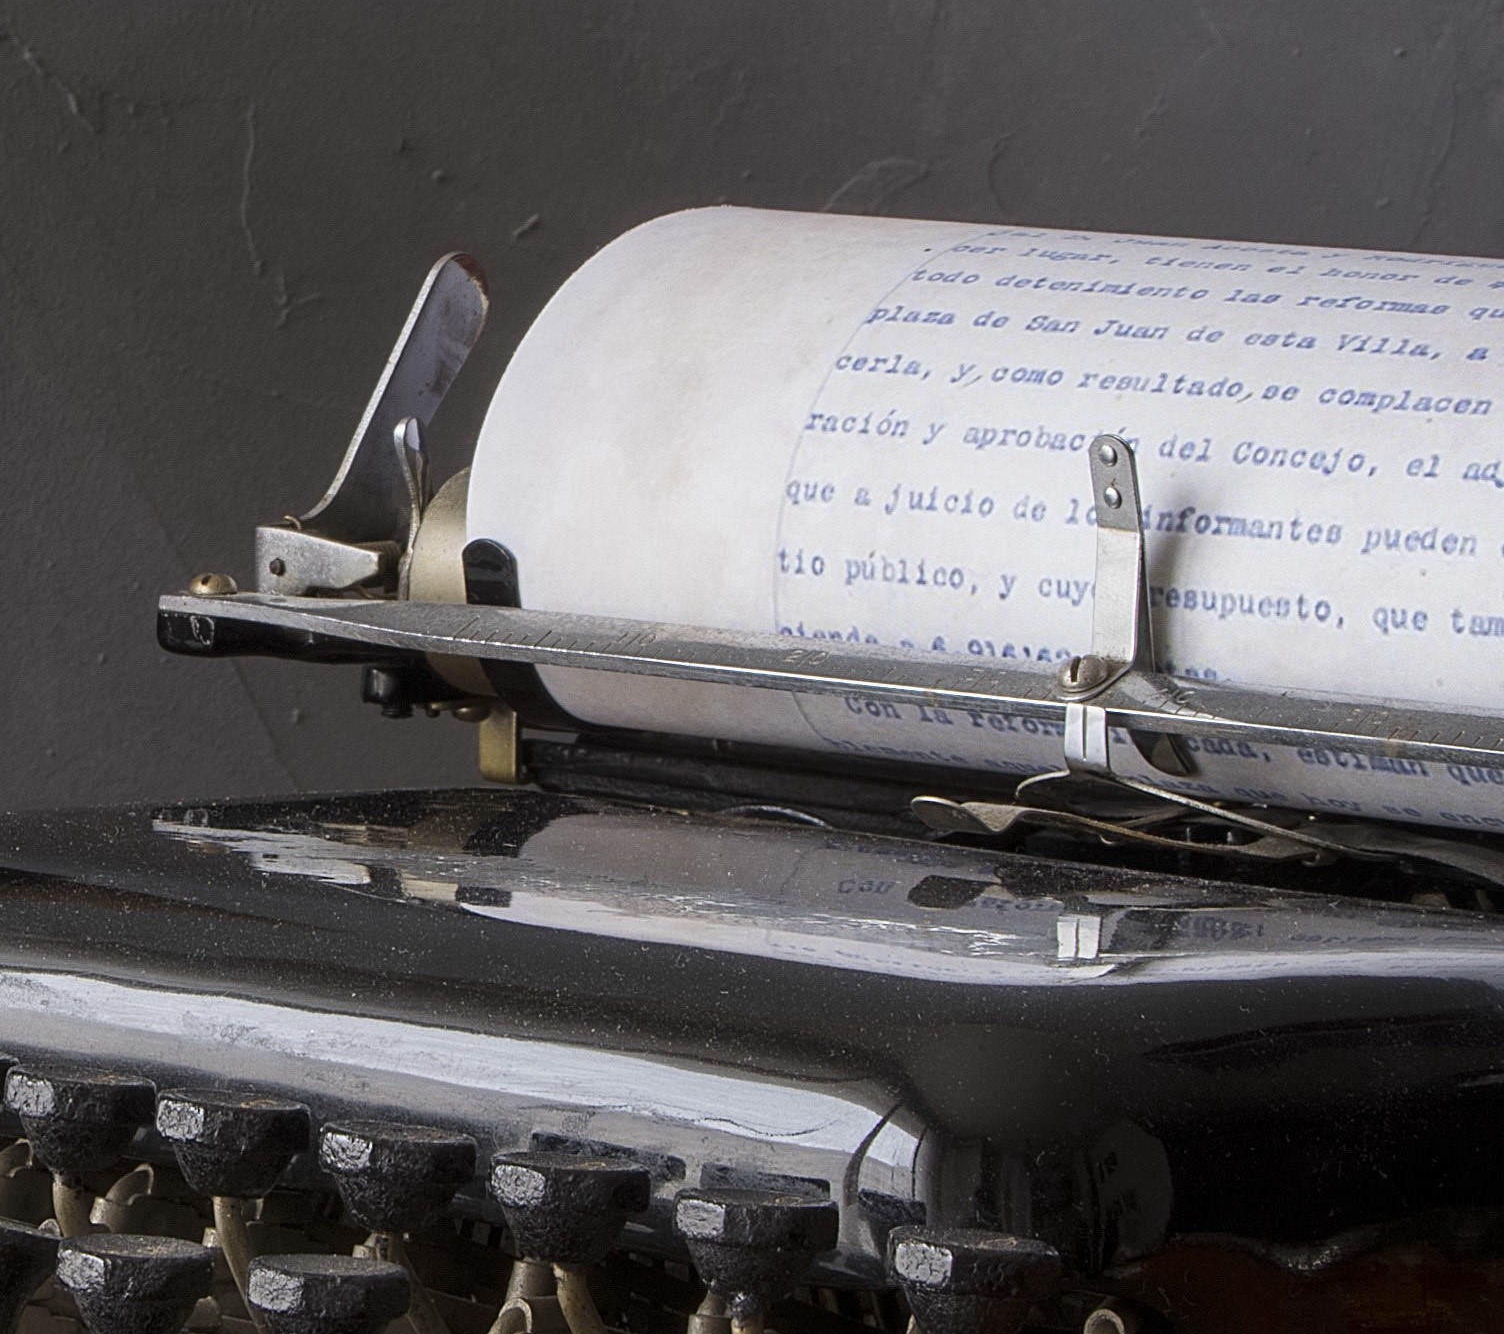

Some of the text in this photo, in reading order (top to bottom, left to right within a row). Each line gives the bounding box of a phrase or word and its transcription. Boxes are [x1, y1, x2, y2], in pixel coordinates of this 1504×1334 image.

[951, 243, 1008, 255] cer
[1018, 247, 1120, 266] lugar,
[1144, 255, 1253, 272] tienen
[1265, 265, 1307, 275] el
[1318, 267, 1421, 282] honor
[1433, 274, 1475, 286] de
[1113, 237, 1190, 248] Juan
[911, 268, 981, 286] todo
[993, 274, 1210, 301] detenimiento
[1222, 288, 1283, 305] las
[1295, 295, 1452, 316] reformas
[869, 305, 957, 327] plaza
[972, 310, 1011, 330] de
[1023, 314, 1082, 335] San
[1092, 318, 1171, 341] Juan
[1185, 324, 1226, 345] de
[1243, 330, 1318, 351] esta
[1335, 332, 1442, 361] Villa,
[1464, 346, 1491, 362] a
[833, 352, 932, 381] cerla,
[1260, 383, 1302, 403] se
[1317, 387, 1494, 418] complacen
[802, 407, 911, 439] ración
[921, 422, 947, 447] y
[962, 424, 1141, 455] aprobacn
[1157, 433, 1213, 464] del
[1231, 440, 1379, 479] Concejo,
[1405, 453, 1441, 480] el
[784, 479, 836, 507] que
[852, 486, 873, 508] a
[883, 482, 996, 519] juicio
[1012, 495, 1048, 523] de
[1064, 498, 1097, 524] lo
[1142, 507, 1344, 545] informantes
[1359, 525, 1478, 557] pueden
[776, 546, 826, 578] tio
[843, 549, 979, 596] público,
[997, 573, 1018, 602] y
[1037, 574, 1097, 607] cuy
[1147, 584, 1346, 628] resupuesto,
[1372, 605, 1429, 636] que
[844, 697, 902, 719] Con
[918, 703, 954, 725] la
[967, 710, 1065, 736] refor
[1445, 762, 1504, 786] que
[1231, 786, 1287, 801] que
[1300, 792, 1362, 811] hoy
[1381, 803, 1422, 817] se
